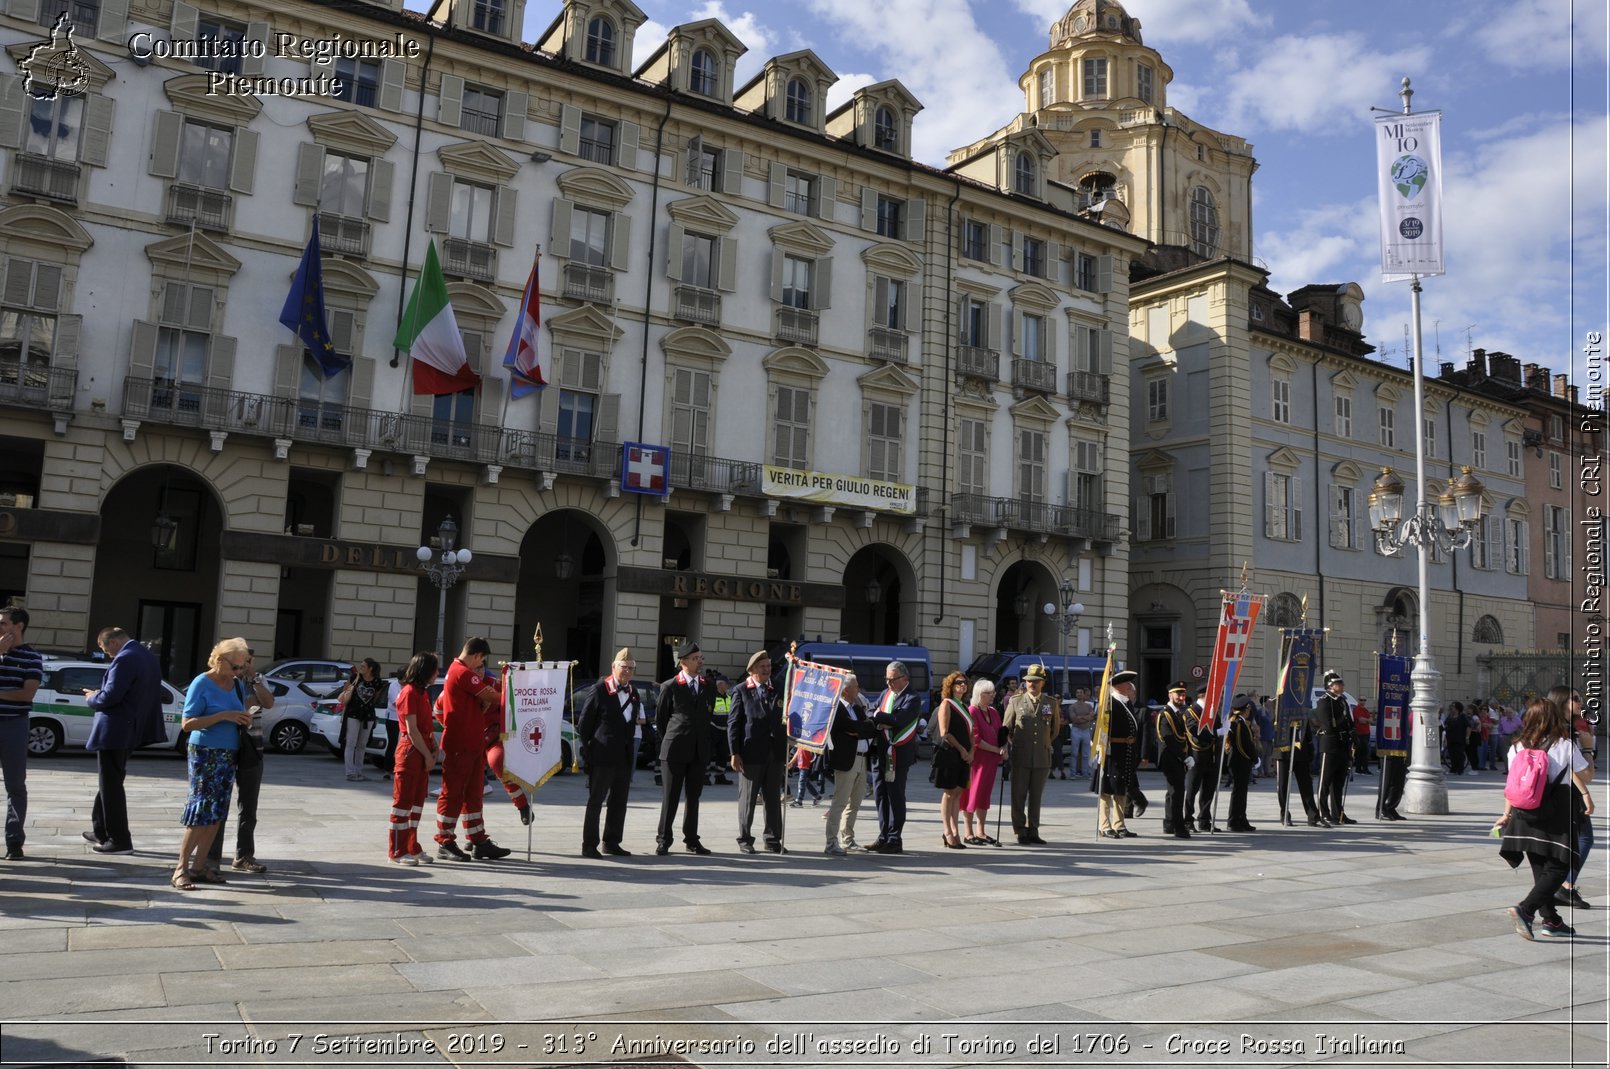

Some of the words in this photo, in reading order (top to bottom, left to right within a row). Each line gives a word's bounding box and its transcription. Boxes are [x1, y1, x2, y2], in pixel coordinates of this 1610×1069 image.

[1403, 229, 1421, 237] 2019
[769, 470, 809, 488] VERITÀ
[812, 476, 833, 490] PER
[836, 479, 870, 495] GIULIO
[873, 484, 909, 500] REGENI
[672, 574, 802, 601] REGIONE
[514, 688, 537, 697] CROCE
[540, 687, 557, 696] ROSSA
[521, 698, 549, 706] ITALIANA
